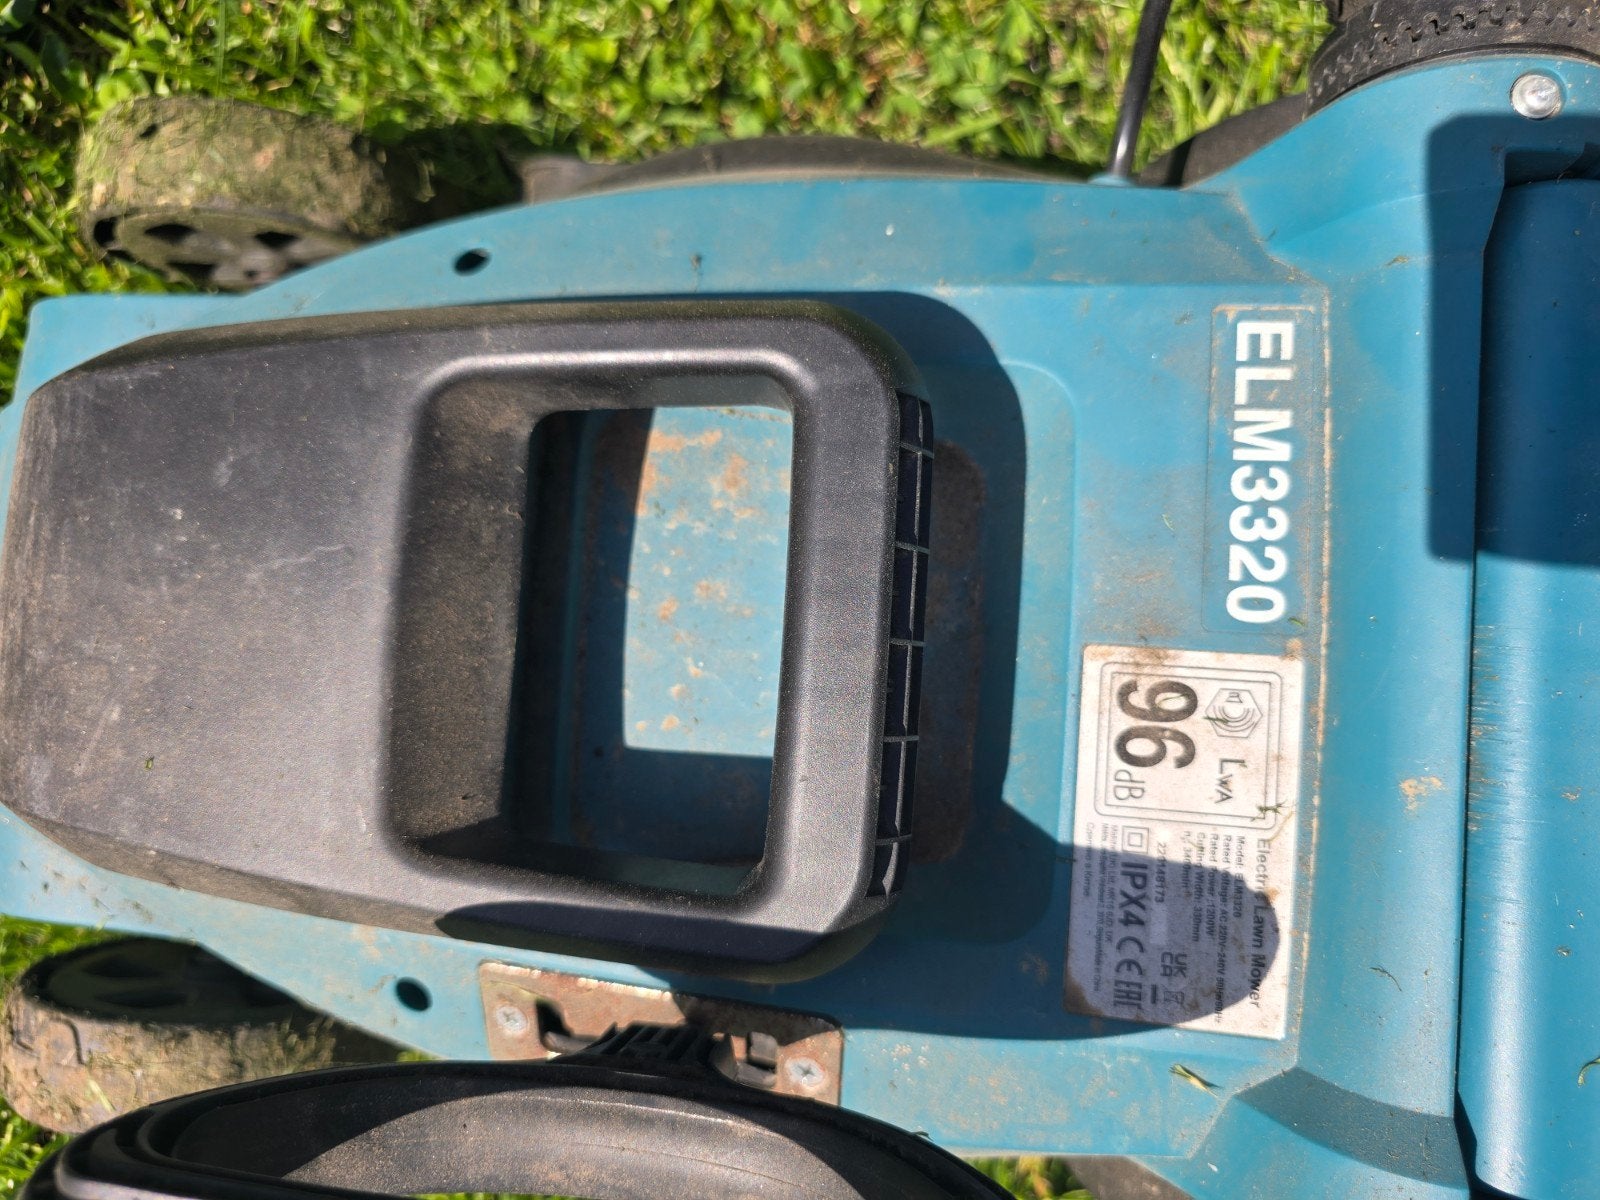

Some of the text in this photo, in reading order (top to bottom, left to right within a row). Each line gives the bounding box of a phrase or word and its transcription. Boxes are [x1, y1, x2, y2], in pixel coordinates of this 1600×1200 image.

[1225, 321, 1297, 625] ELM3320
[1113, 681, 1199, 801] 96 dB
[1208, 833, 1219, 862] Rated
[1221, 834, 1232, 864] Rated
[1118, 862, 1149, 927] IPX4
[1191, 832, 1206, 943] Cutting Width: 330mm
[1207, 866, 1218, 897] Power
[1217, 866, 1231, 906] Voltage:
[1232, 835, 1246, 918] Model: ELM3320
[1218, 908, 1228, 922] AC
[1248, 838, 1272, 1008] Electric Lawn Mower
[1160, 951, 1174, 977] CA
[1173, 952, 1188, 979] UK
